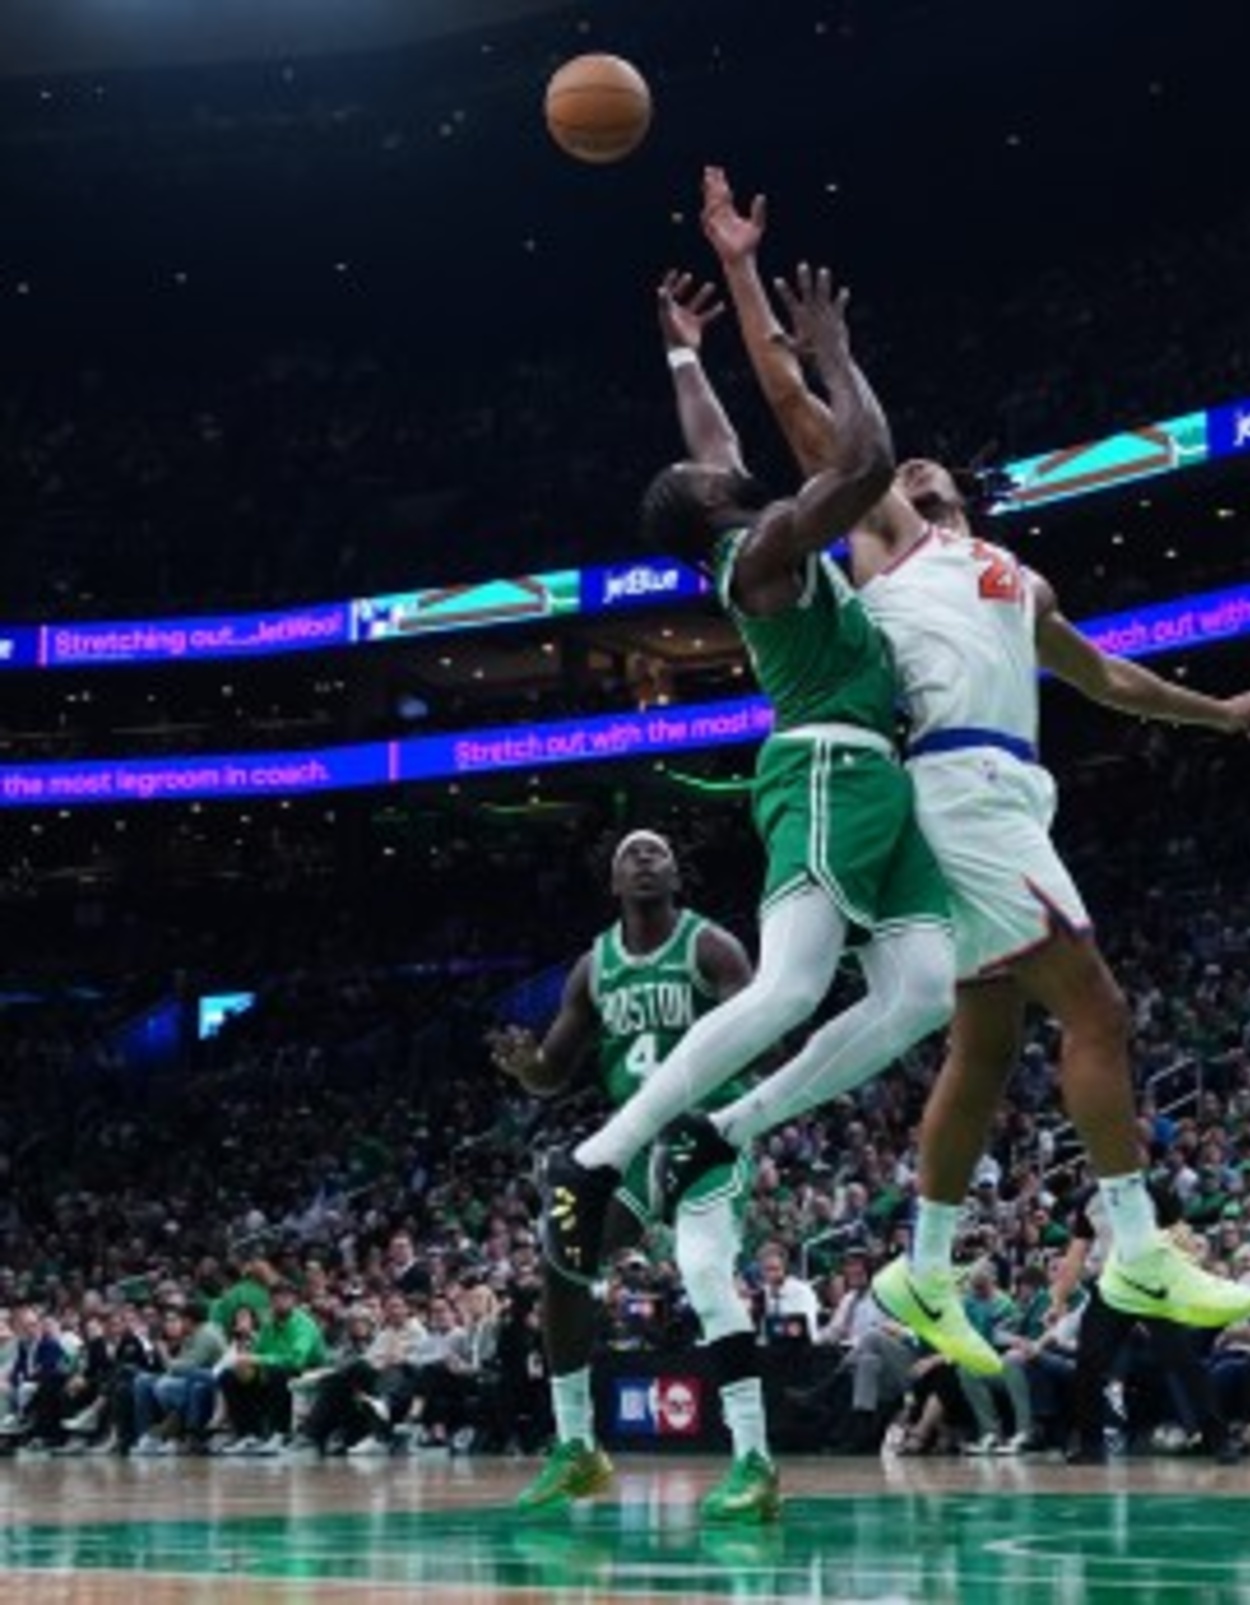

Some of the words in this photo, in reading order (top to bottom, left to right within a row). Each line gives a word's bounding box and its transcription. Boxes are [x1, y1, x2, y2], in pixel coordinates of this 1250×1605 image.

[602, 565, 679, 604] jetBlue
[54, 628, 187, 656] Stretching
[1153, 611, 1194, 643] out
[454, 732, 544, 763] Stretch
[547, 730, 588, 756] out
[590, 722, 642, 749] with
[648, 716, 688, 742] the
[690, 709, 749, 738] most
[2, 773, 43, 797] the
[49, 770, 113, 796] most
[115, 763, 219, 799] legroom
[224, 765, 247, 787] in
[250, 758, 331, 788] coach.
[602, 982, 694, 1035] BOSTON
